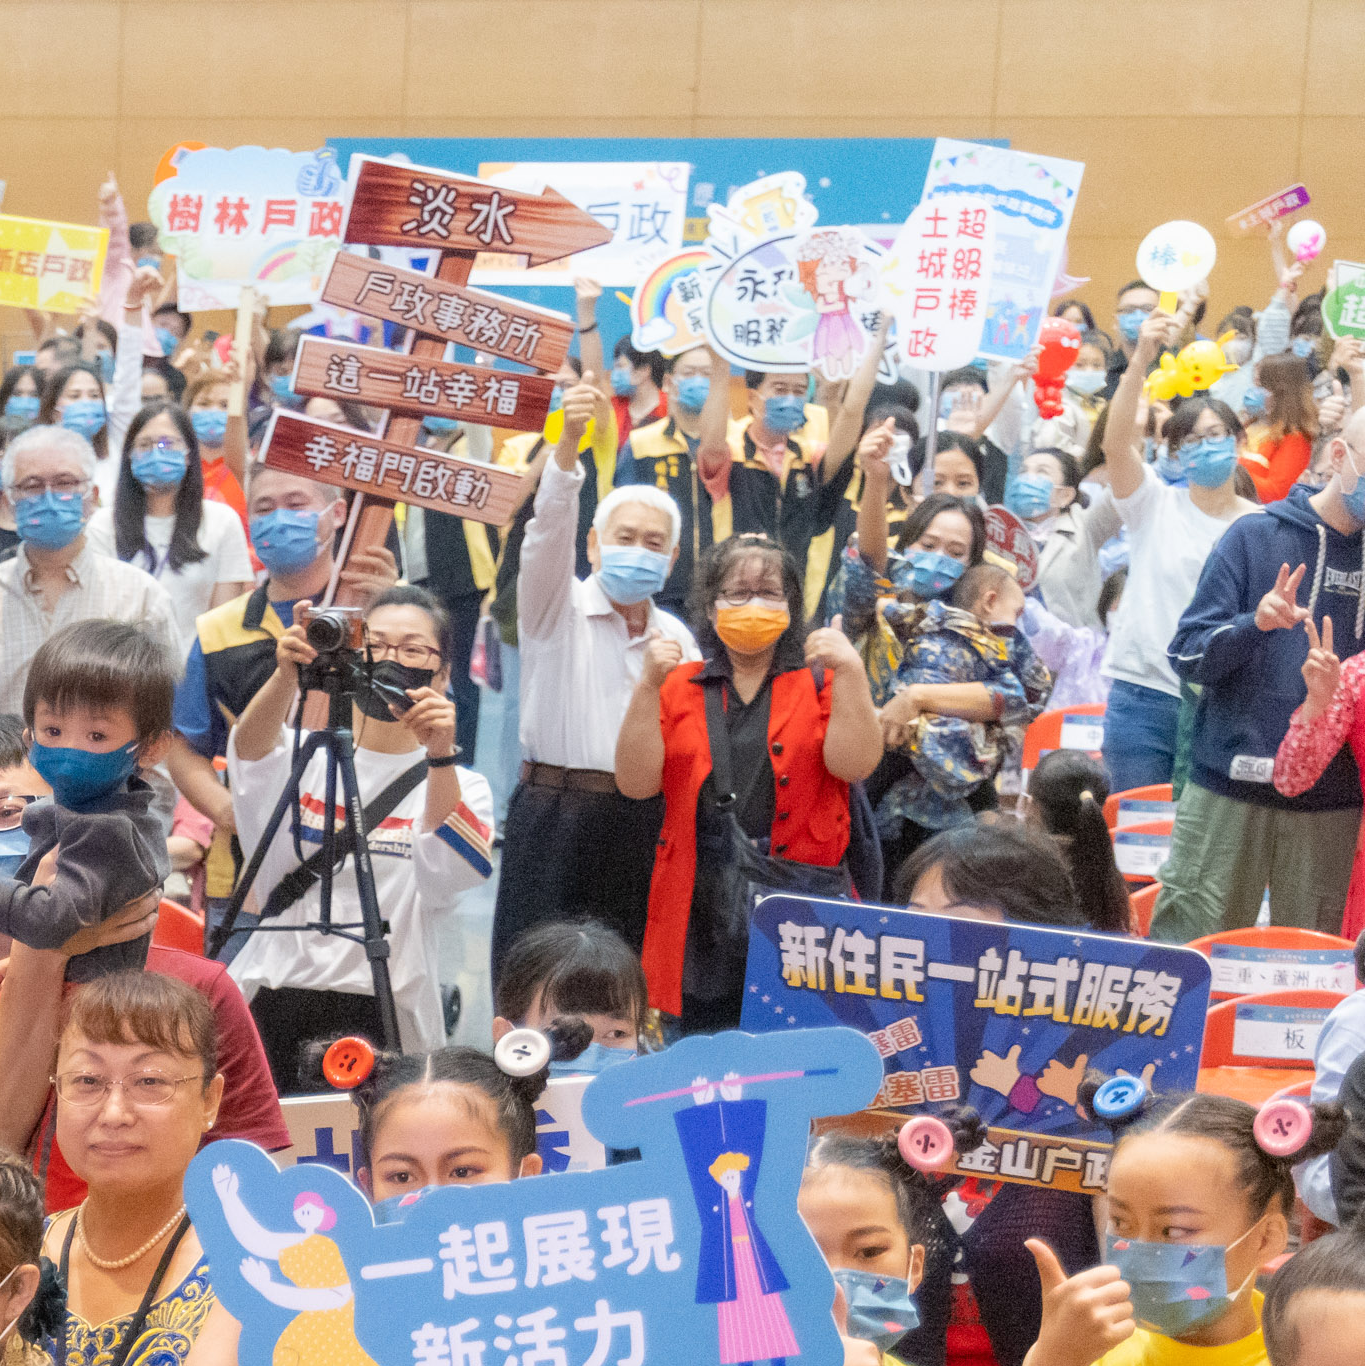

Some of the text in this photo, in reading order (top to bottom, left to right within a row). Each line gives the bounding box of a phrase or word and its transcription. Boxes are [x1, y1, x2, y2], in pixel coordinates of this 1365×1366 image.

[167, 193, 344, 238] 樹林戶政
[401, 180, 516, 246] 淡水
[907, 207, 949, 358] 土城戶政
[948, 207, 987, 320] 超級棒
[356, 273, 543, 362] 戶政事務所
[324, 354, 521, 418] 這一站幸福
[305, 434, 494, 511] 幸福門啟動
[777, 919, 1183, 1038] 新住民一站式服務
[1283, 1027, 1307, 1051] 板
[360, 1198, 682, 1301] 一起展現
